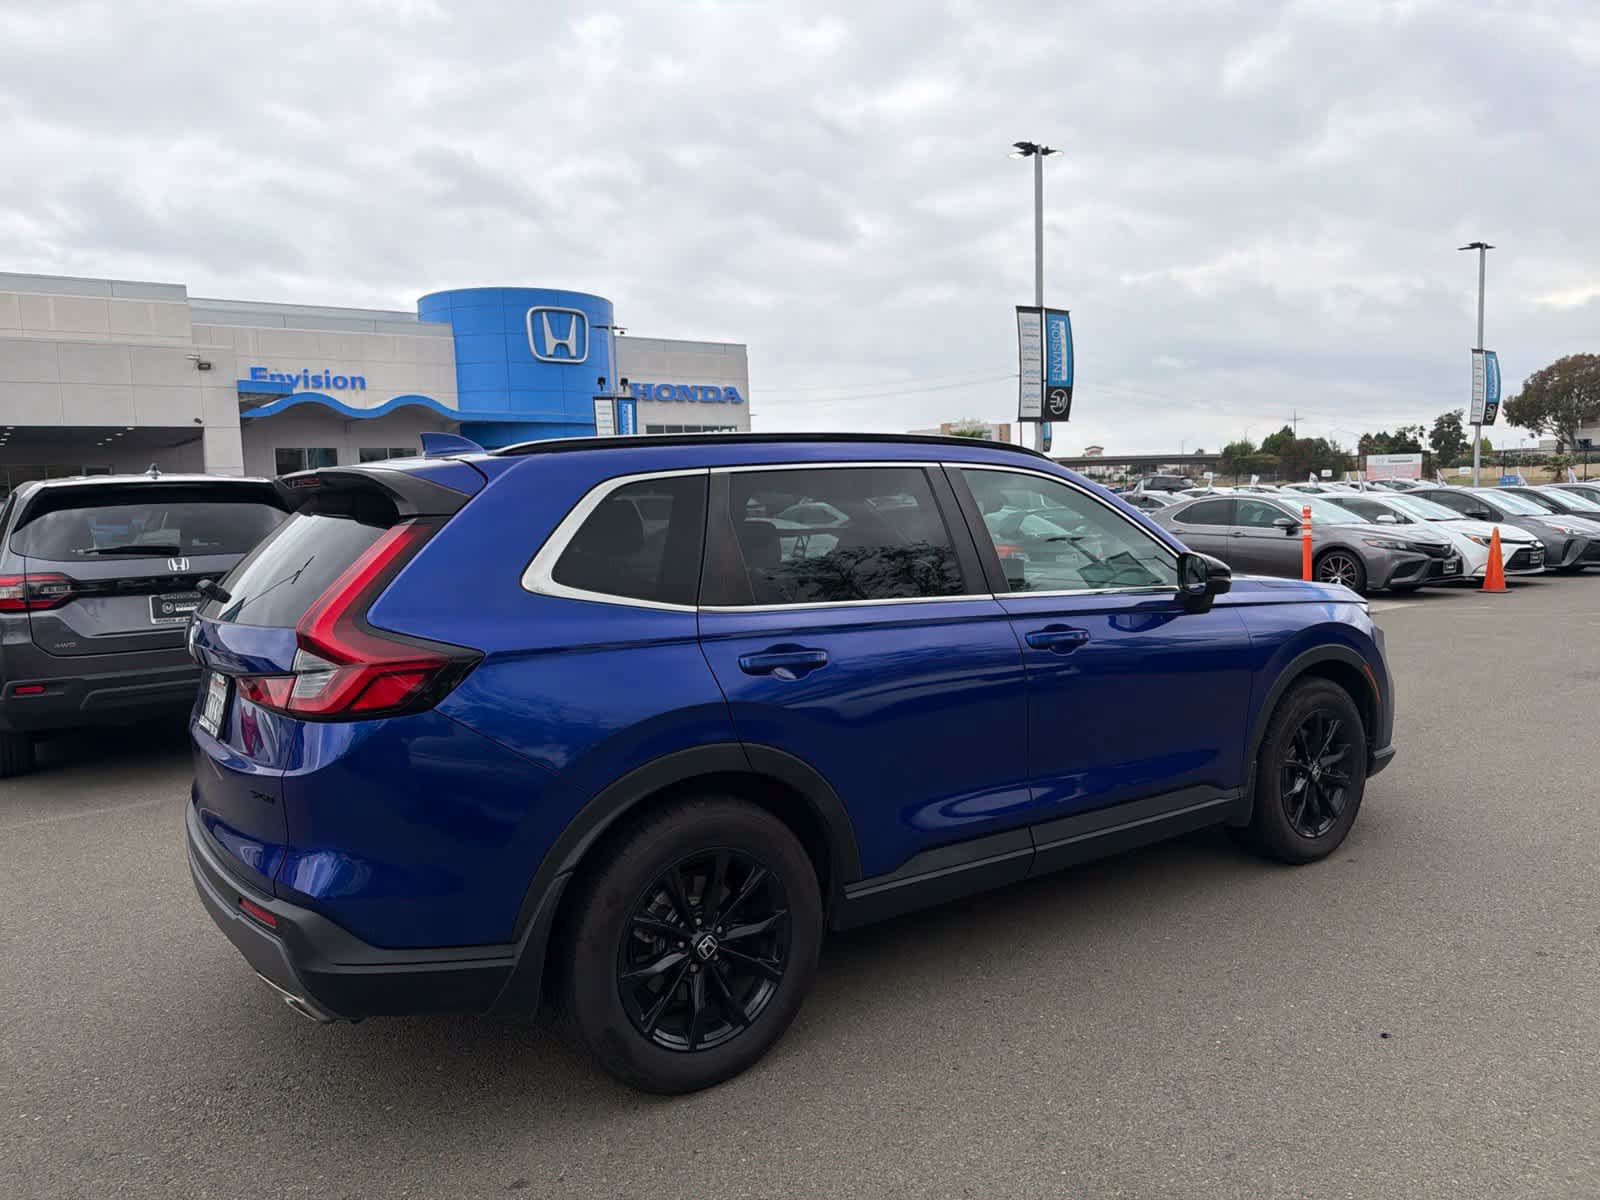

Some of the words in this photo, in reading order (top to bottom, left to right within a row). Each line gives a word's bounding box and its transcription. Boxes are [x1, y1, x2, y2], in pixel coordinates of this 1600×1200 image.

[1051, 320, 1062, 381] ENVISION
[250, 367, 366, 390] Envision
[629, 383, 744, 405] HONDA
